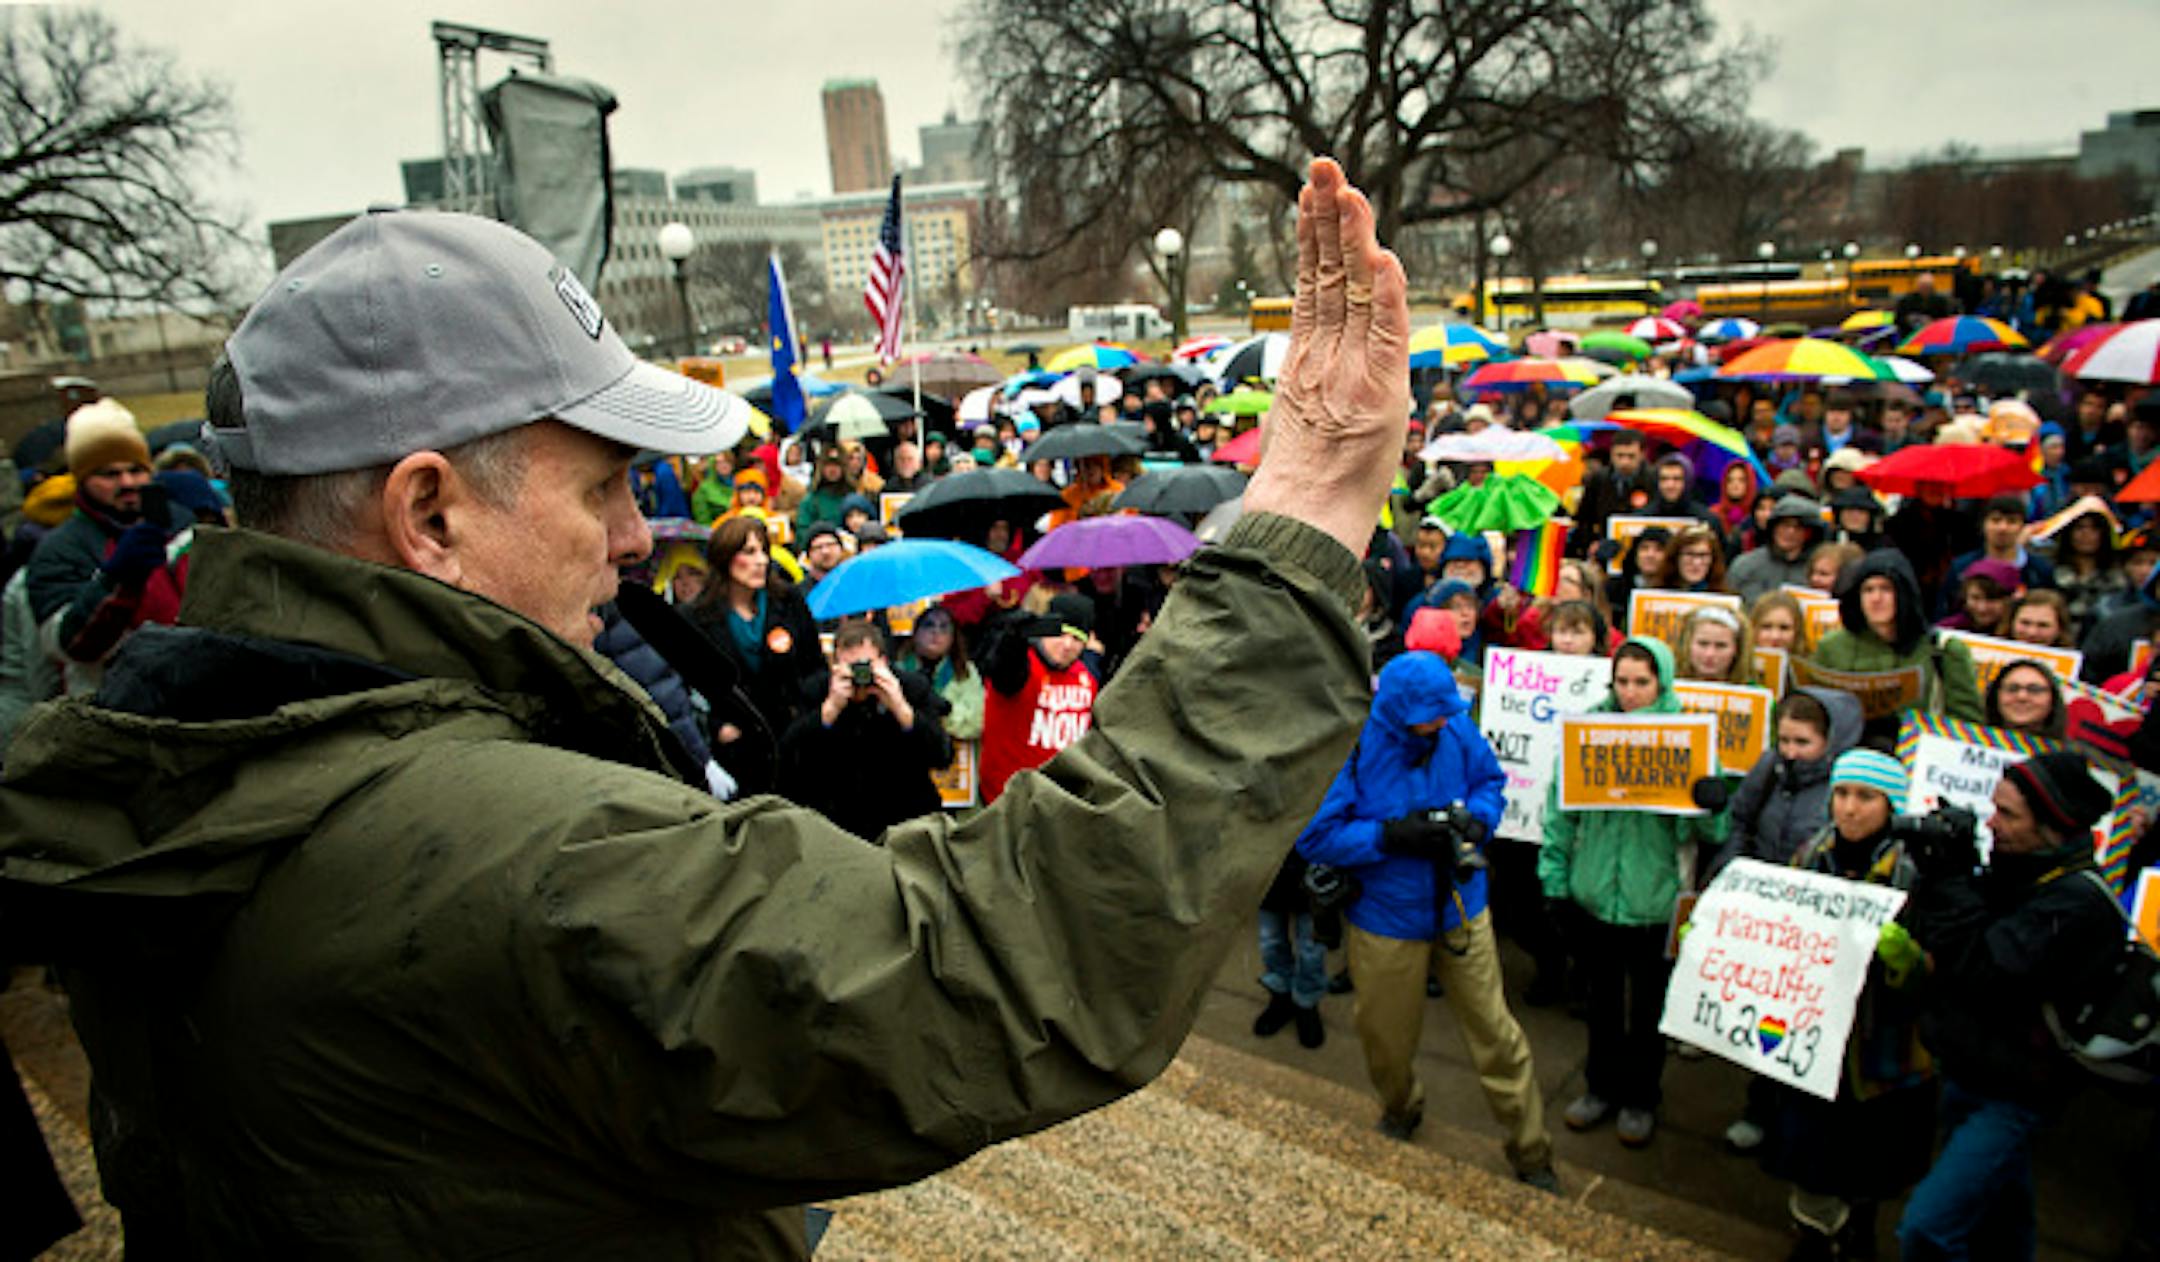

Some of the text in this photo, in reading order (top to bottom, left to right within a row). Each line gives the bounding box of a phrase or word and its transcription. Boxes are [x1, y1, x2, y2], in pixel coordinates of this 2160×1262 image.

[1489, 652, 1595, 697] Mother of
[1580, 745, 1691, 769] FREEDOM
[1590, 729, 1658, 747] SUPPORT
[1662, 730, 1692, 748] THE
[1583, 766, 1689, 789] TO MARRY
[1715, 906, 1838, 973] Marriage
[1699, 948, 1826, 1031] Equality
[1693, 992, 1723, 1035] in
